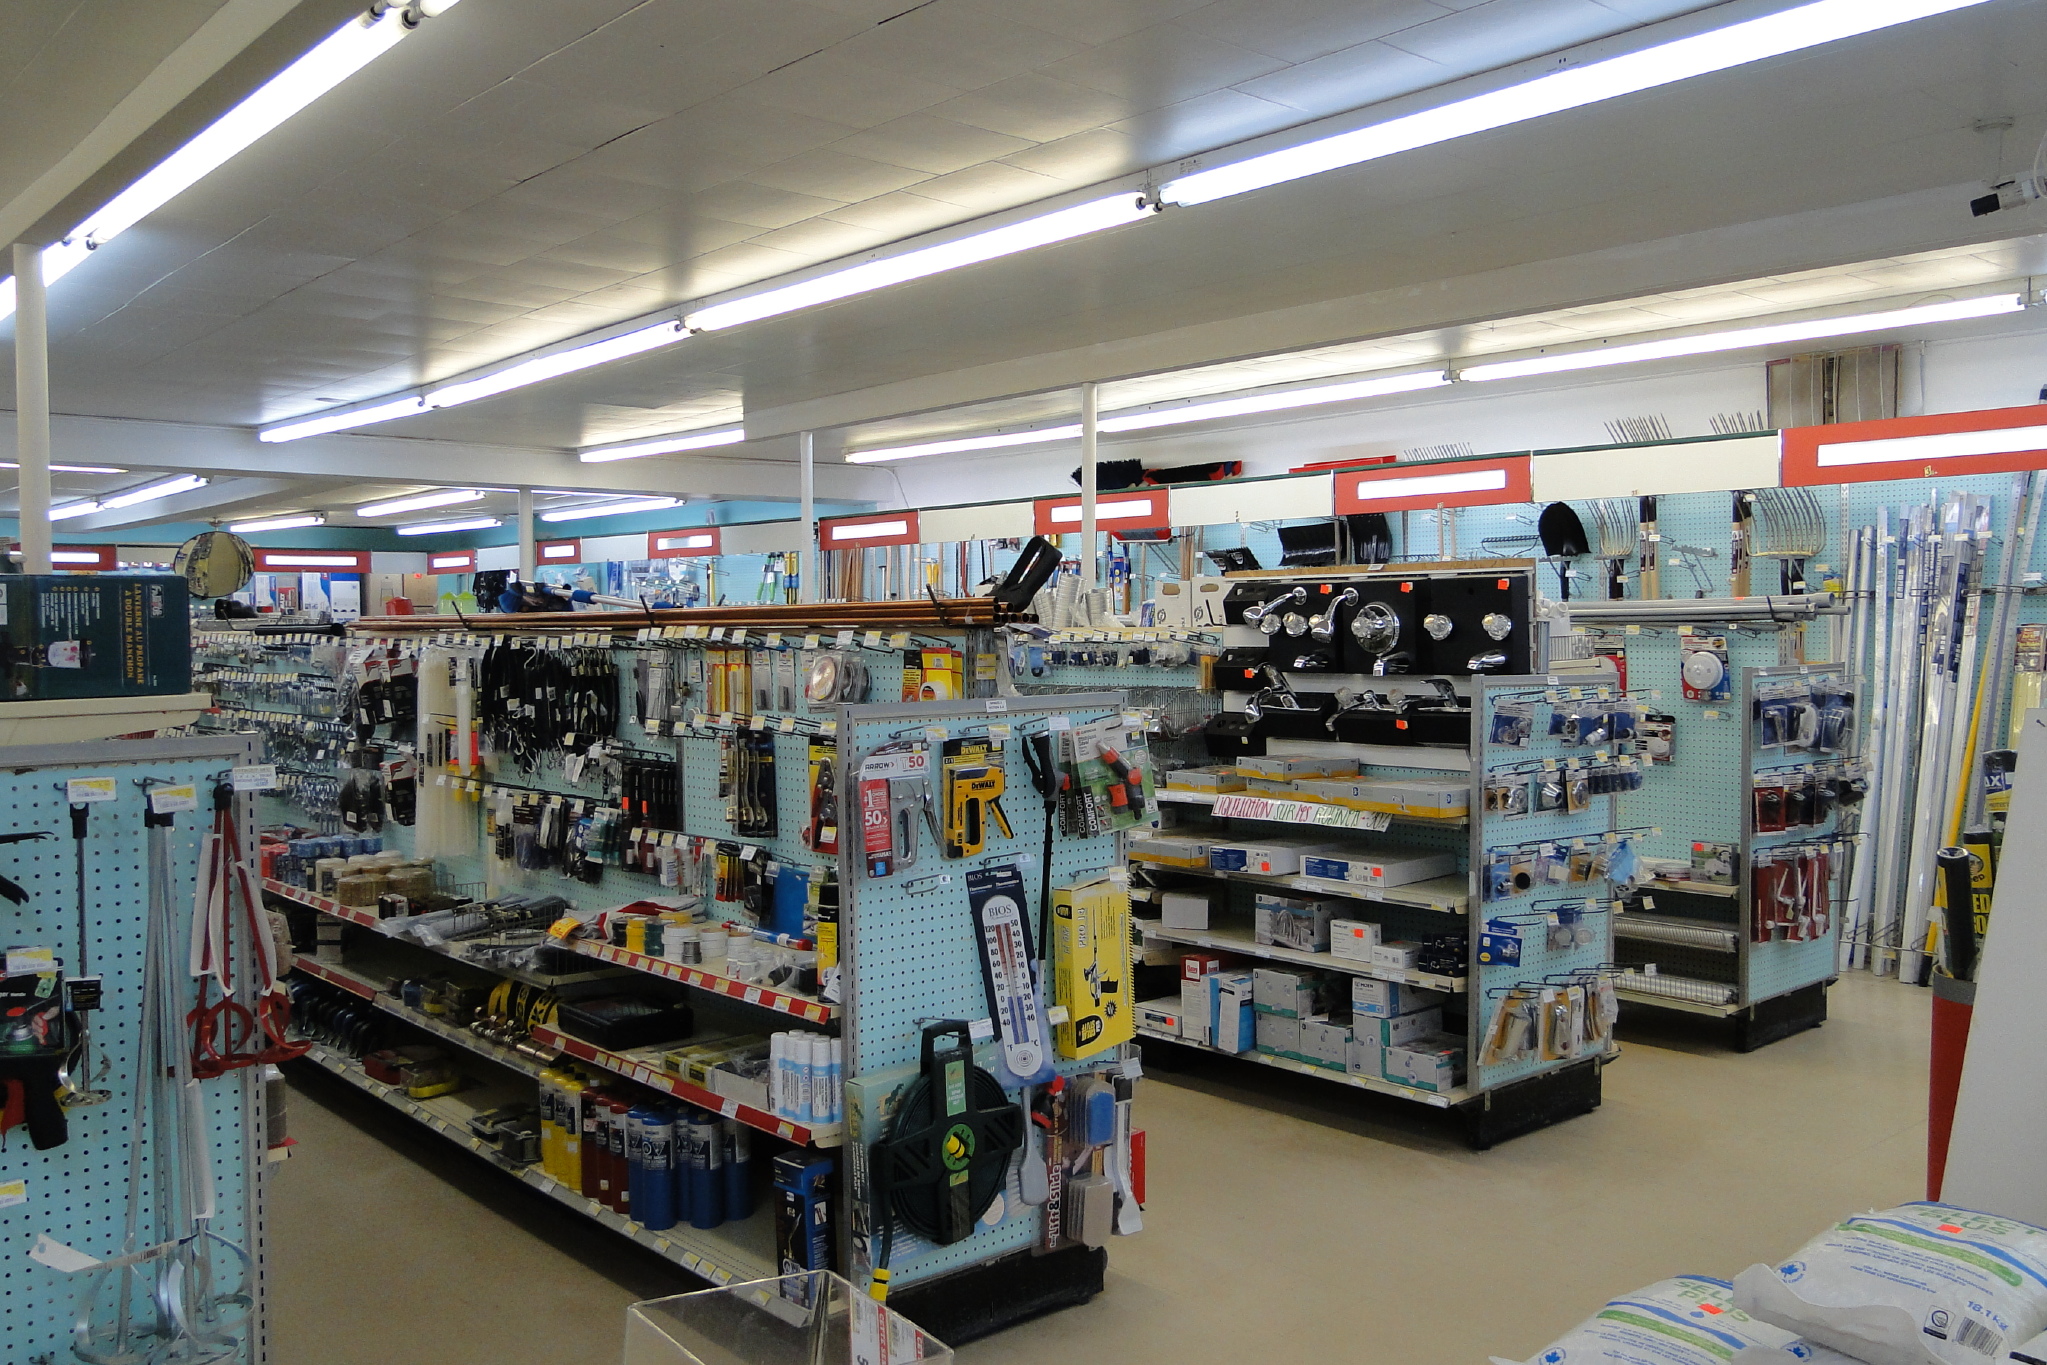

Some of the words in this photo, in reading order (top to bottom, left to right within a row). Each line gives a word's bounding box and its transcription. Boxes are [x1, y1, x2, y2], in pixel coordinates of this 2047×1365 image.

[134, 583, 142, 628] LANTERNE
[125, 598, 133, 633] DOUBLE
[136, 630, 143, 642] AU
[136, 644, 145, 685] PROPANE
[864, 761, 889, 770] ARROW
[1075, 795, 1086, 833] COMFORT
[1084, 792, 1098, 832] COMFORT
[865, 810, 882, 827] 50
[988, 904, 1012, 917] BIOS
[1078, 907, 1088, 921] 14
[1010, 919, 1019, 927] 50
[985, 925, 996, 933] 120
[986, 936, 997, 944] 100
[1078, 924, 1088, 949] PRO
[1013, 940, 1022, 948] 30
[990, 948, 999, 956] 80
[992, 960, 1001, 968] 60
[1018, 961, 1025, 969] 10
[994, 971, 1003, 979] 40
[996, 983, 1005, 991] 20
[1022, 982, 1030, 990] 10
[1023, 992, 1032, 1000] 20
[1001, 1006, 1009, 1014] 20
[1025, 1003, 1034, 1011] 30
[1027, 1013, 1036, 1021] 40
[1003, 1018, 1011, 1026] 40
[1966, 1300, 1991, 1318] 18.1
